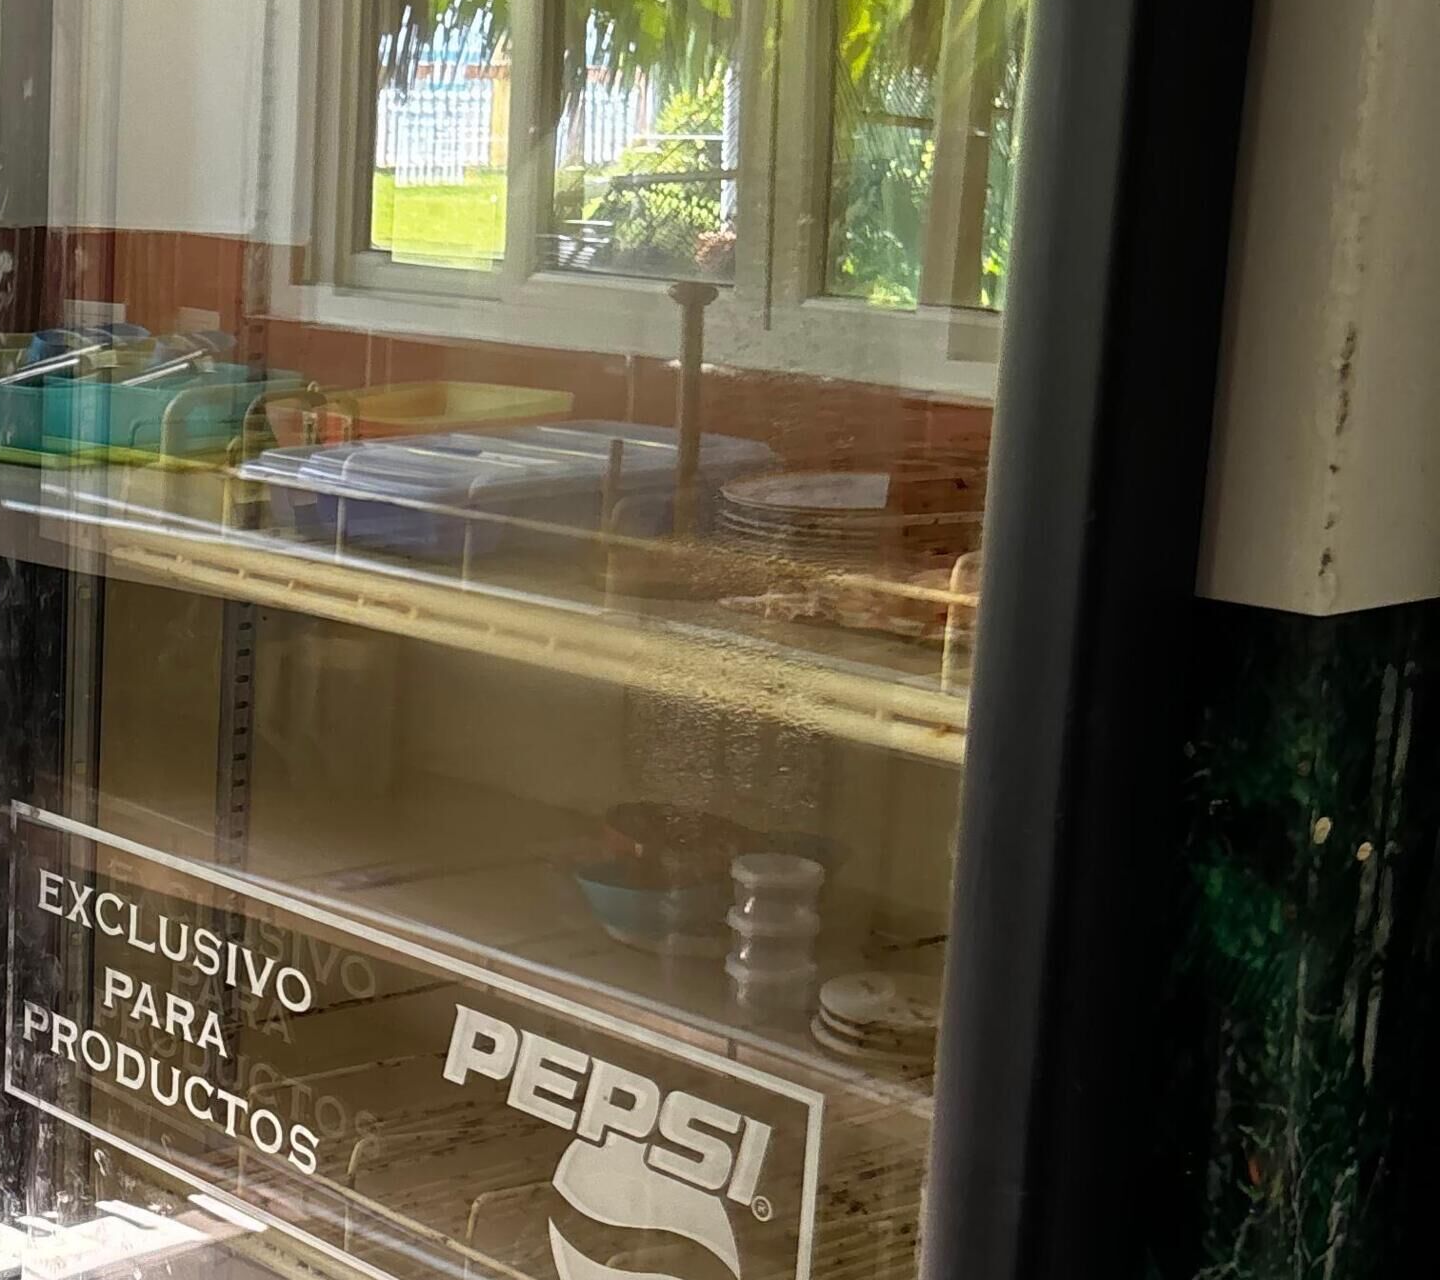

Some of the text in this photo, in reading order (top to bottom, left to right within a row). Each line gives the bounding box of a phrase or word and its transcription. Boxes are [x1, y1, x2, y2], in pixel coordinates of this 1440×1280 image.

[37, 868, 312, 1013] EXCLUSIVO
[103, 966, 229, 1058] PARA
[22, 1000, 320, 1175] PRODUCTOS
[442, 1003, 773, 1207] PEPSI
